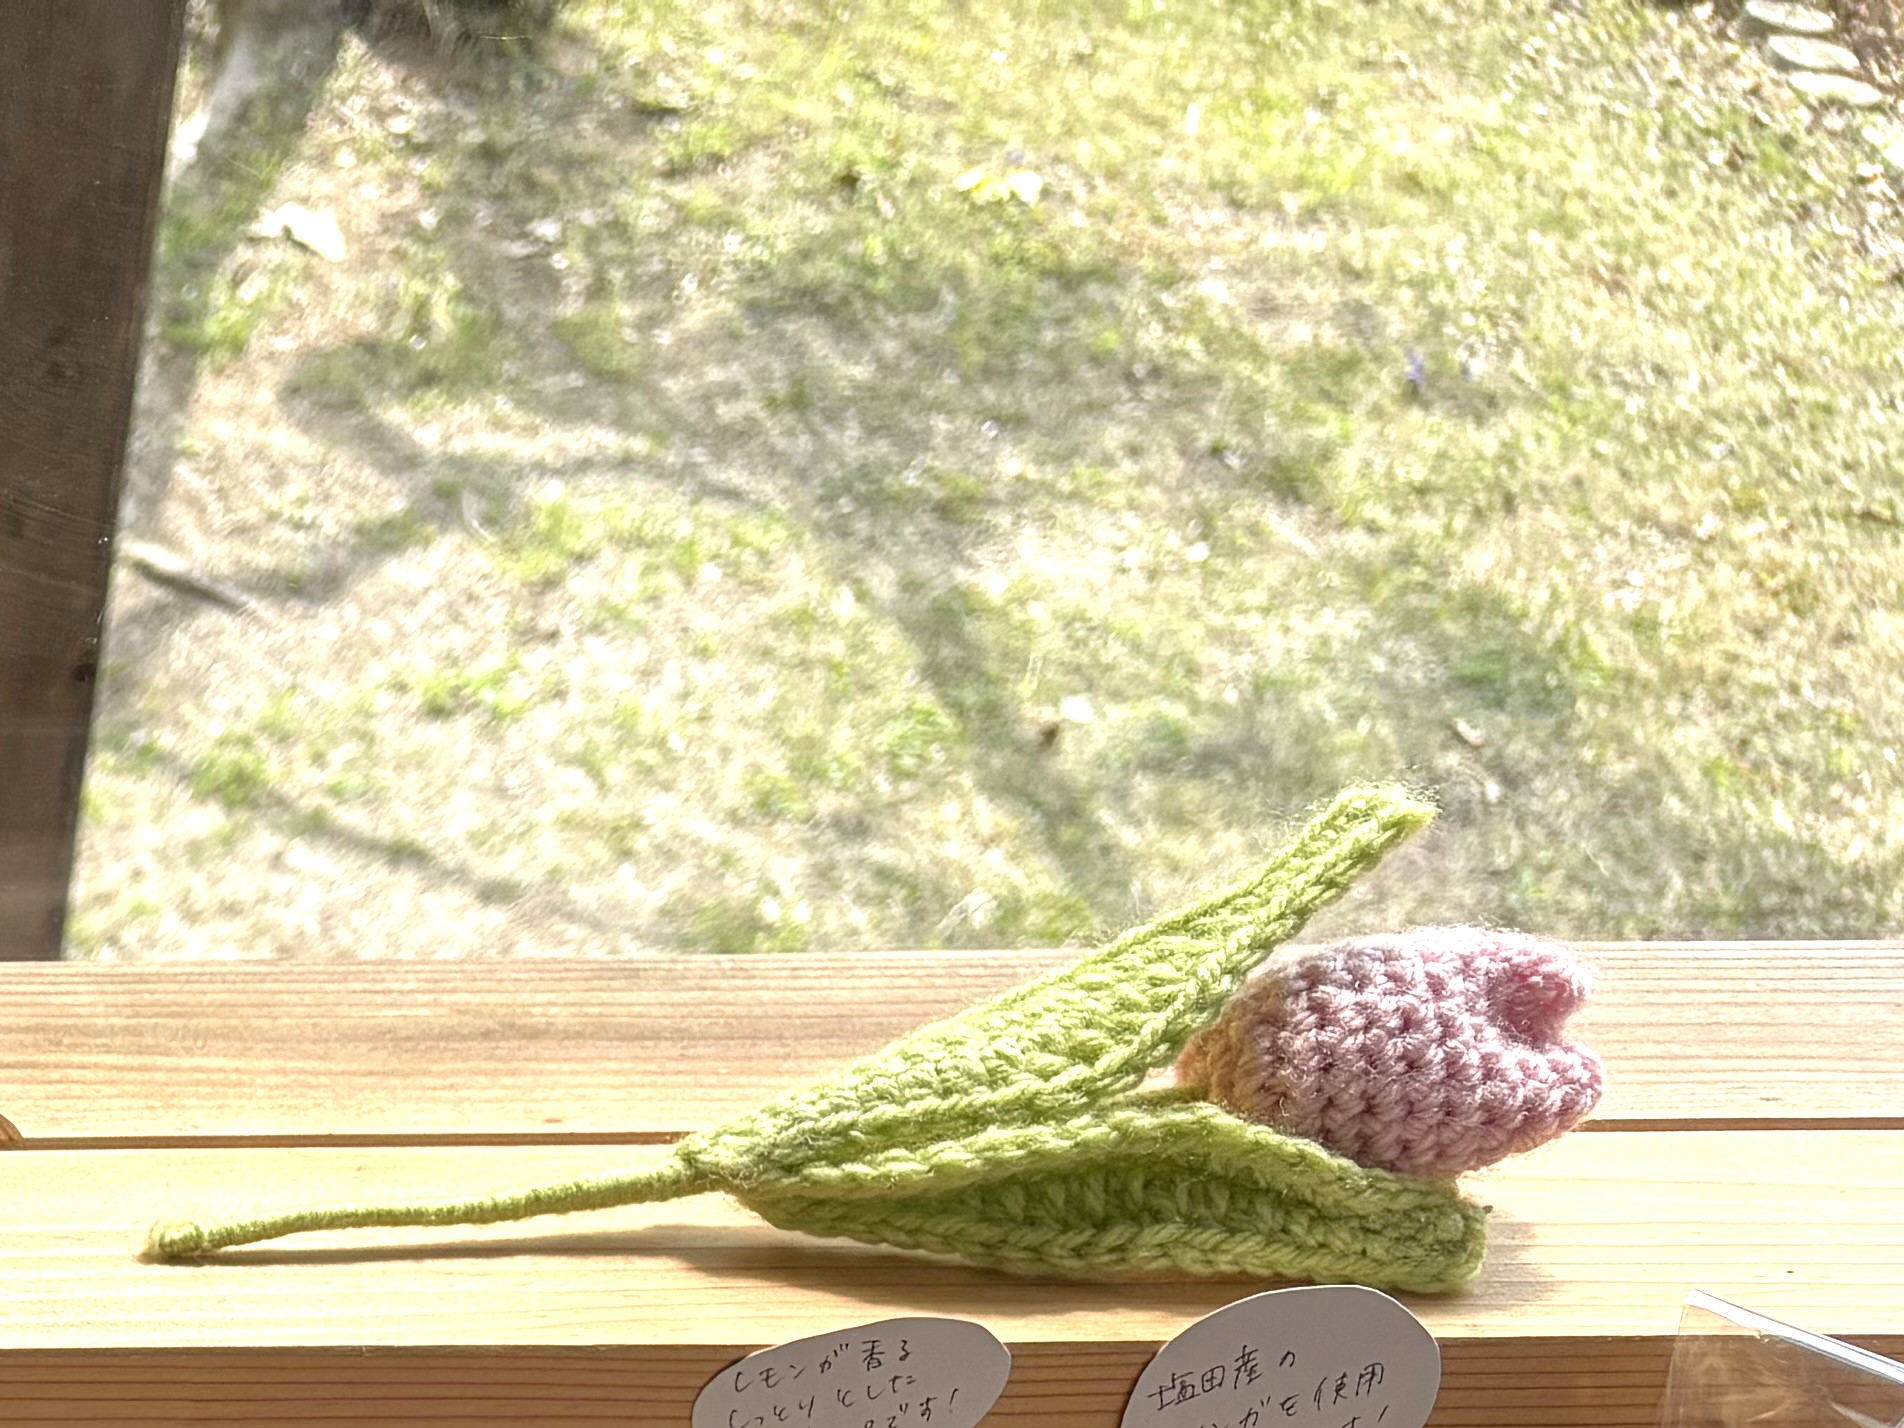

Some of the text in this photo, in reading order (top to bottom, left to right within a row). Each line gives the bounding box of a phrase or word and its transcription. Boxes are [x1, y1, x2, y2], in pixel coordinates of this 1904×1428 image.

[734, 1340, 914, 1393] レモンが香る
[1147, 1344, 1296, 1411] 塩田産の
